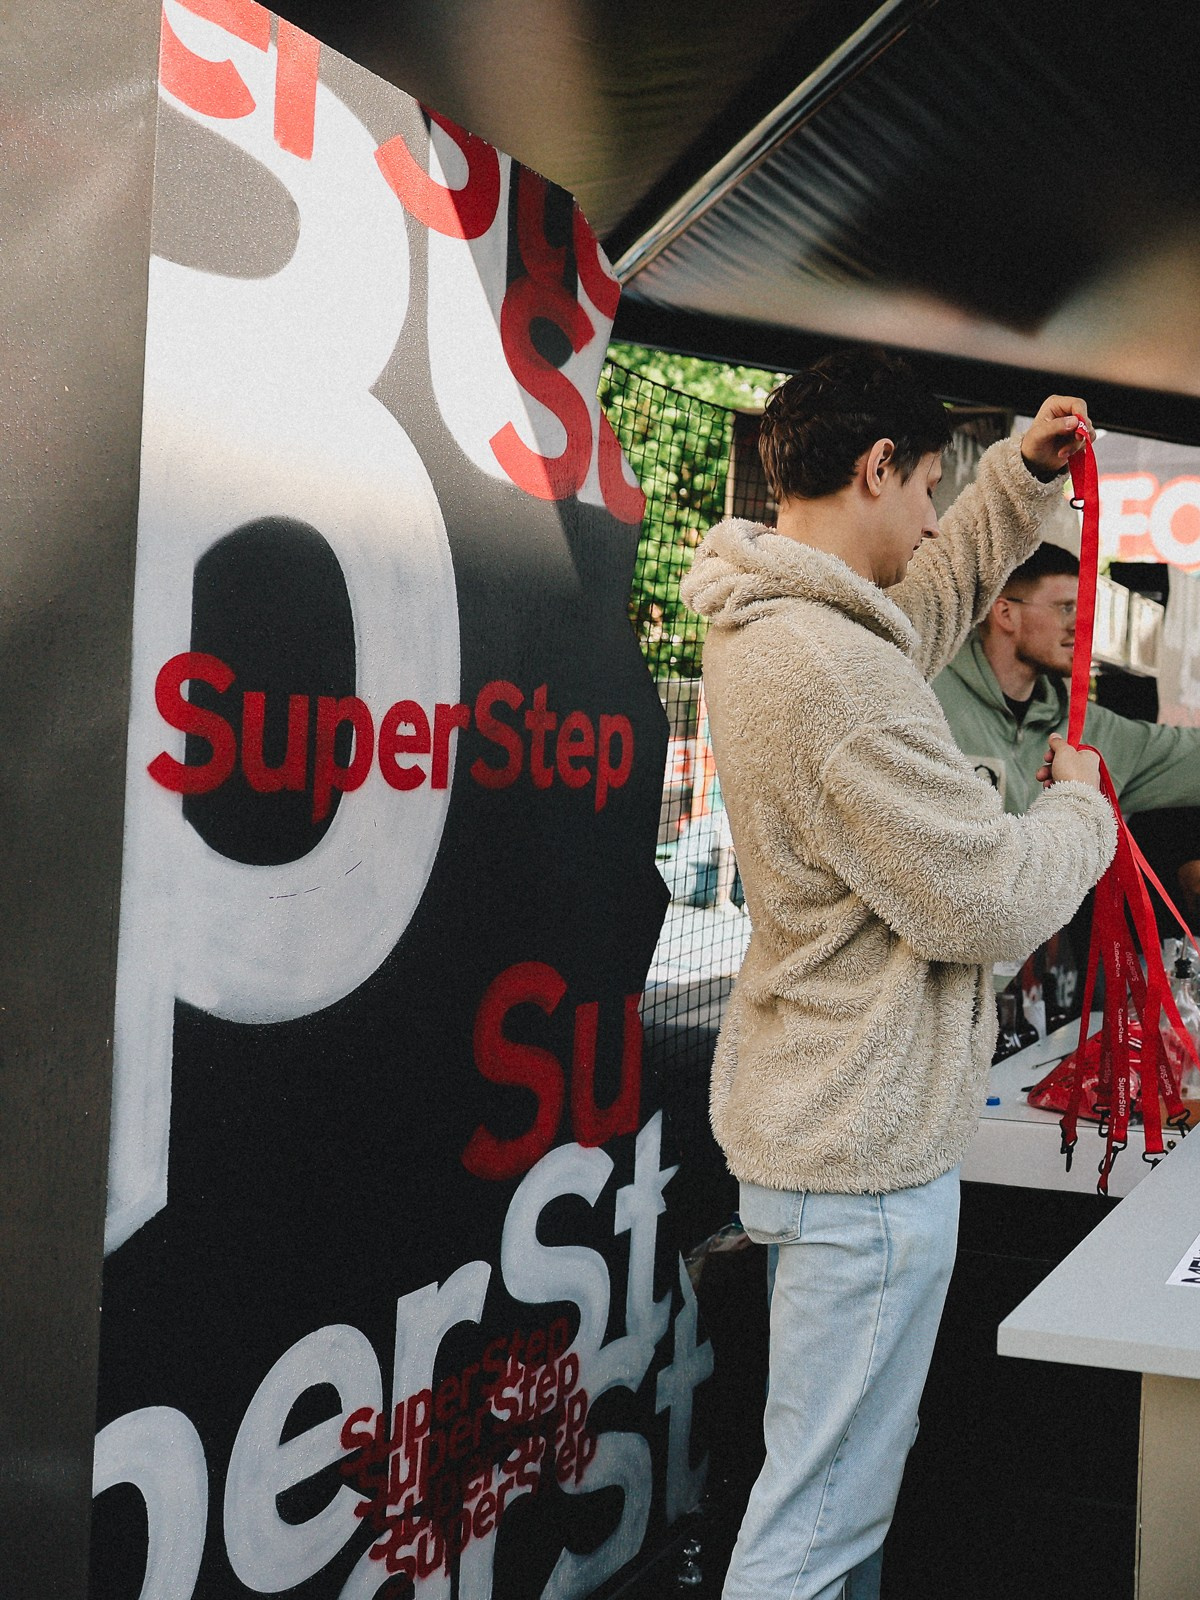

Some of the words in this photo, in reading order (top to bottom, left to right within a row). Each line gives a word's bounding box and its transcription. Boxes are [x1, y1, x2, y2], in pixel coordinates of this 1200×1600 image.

[147, 651, 634, 824] SuperStep
[461, 961, 645, 1182] Su
[1118, 1077, 1127, 1117] SuperStep
